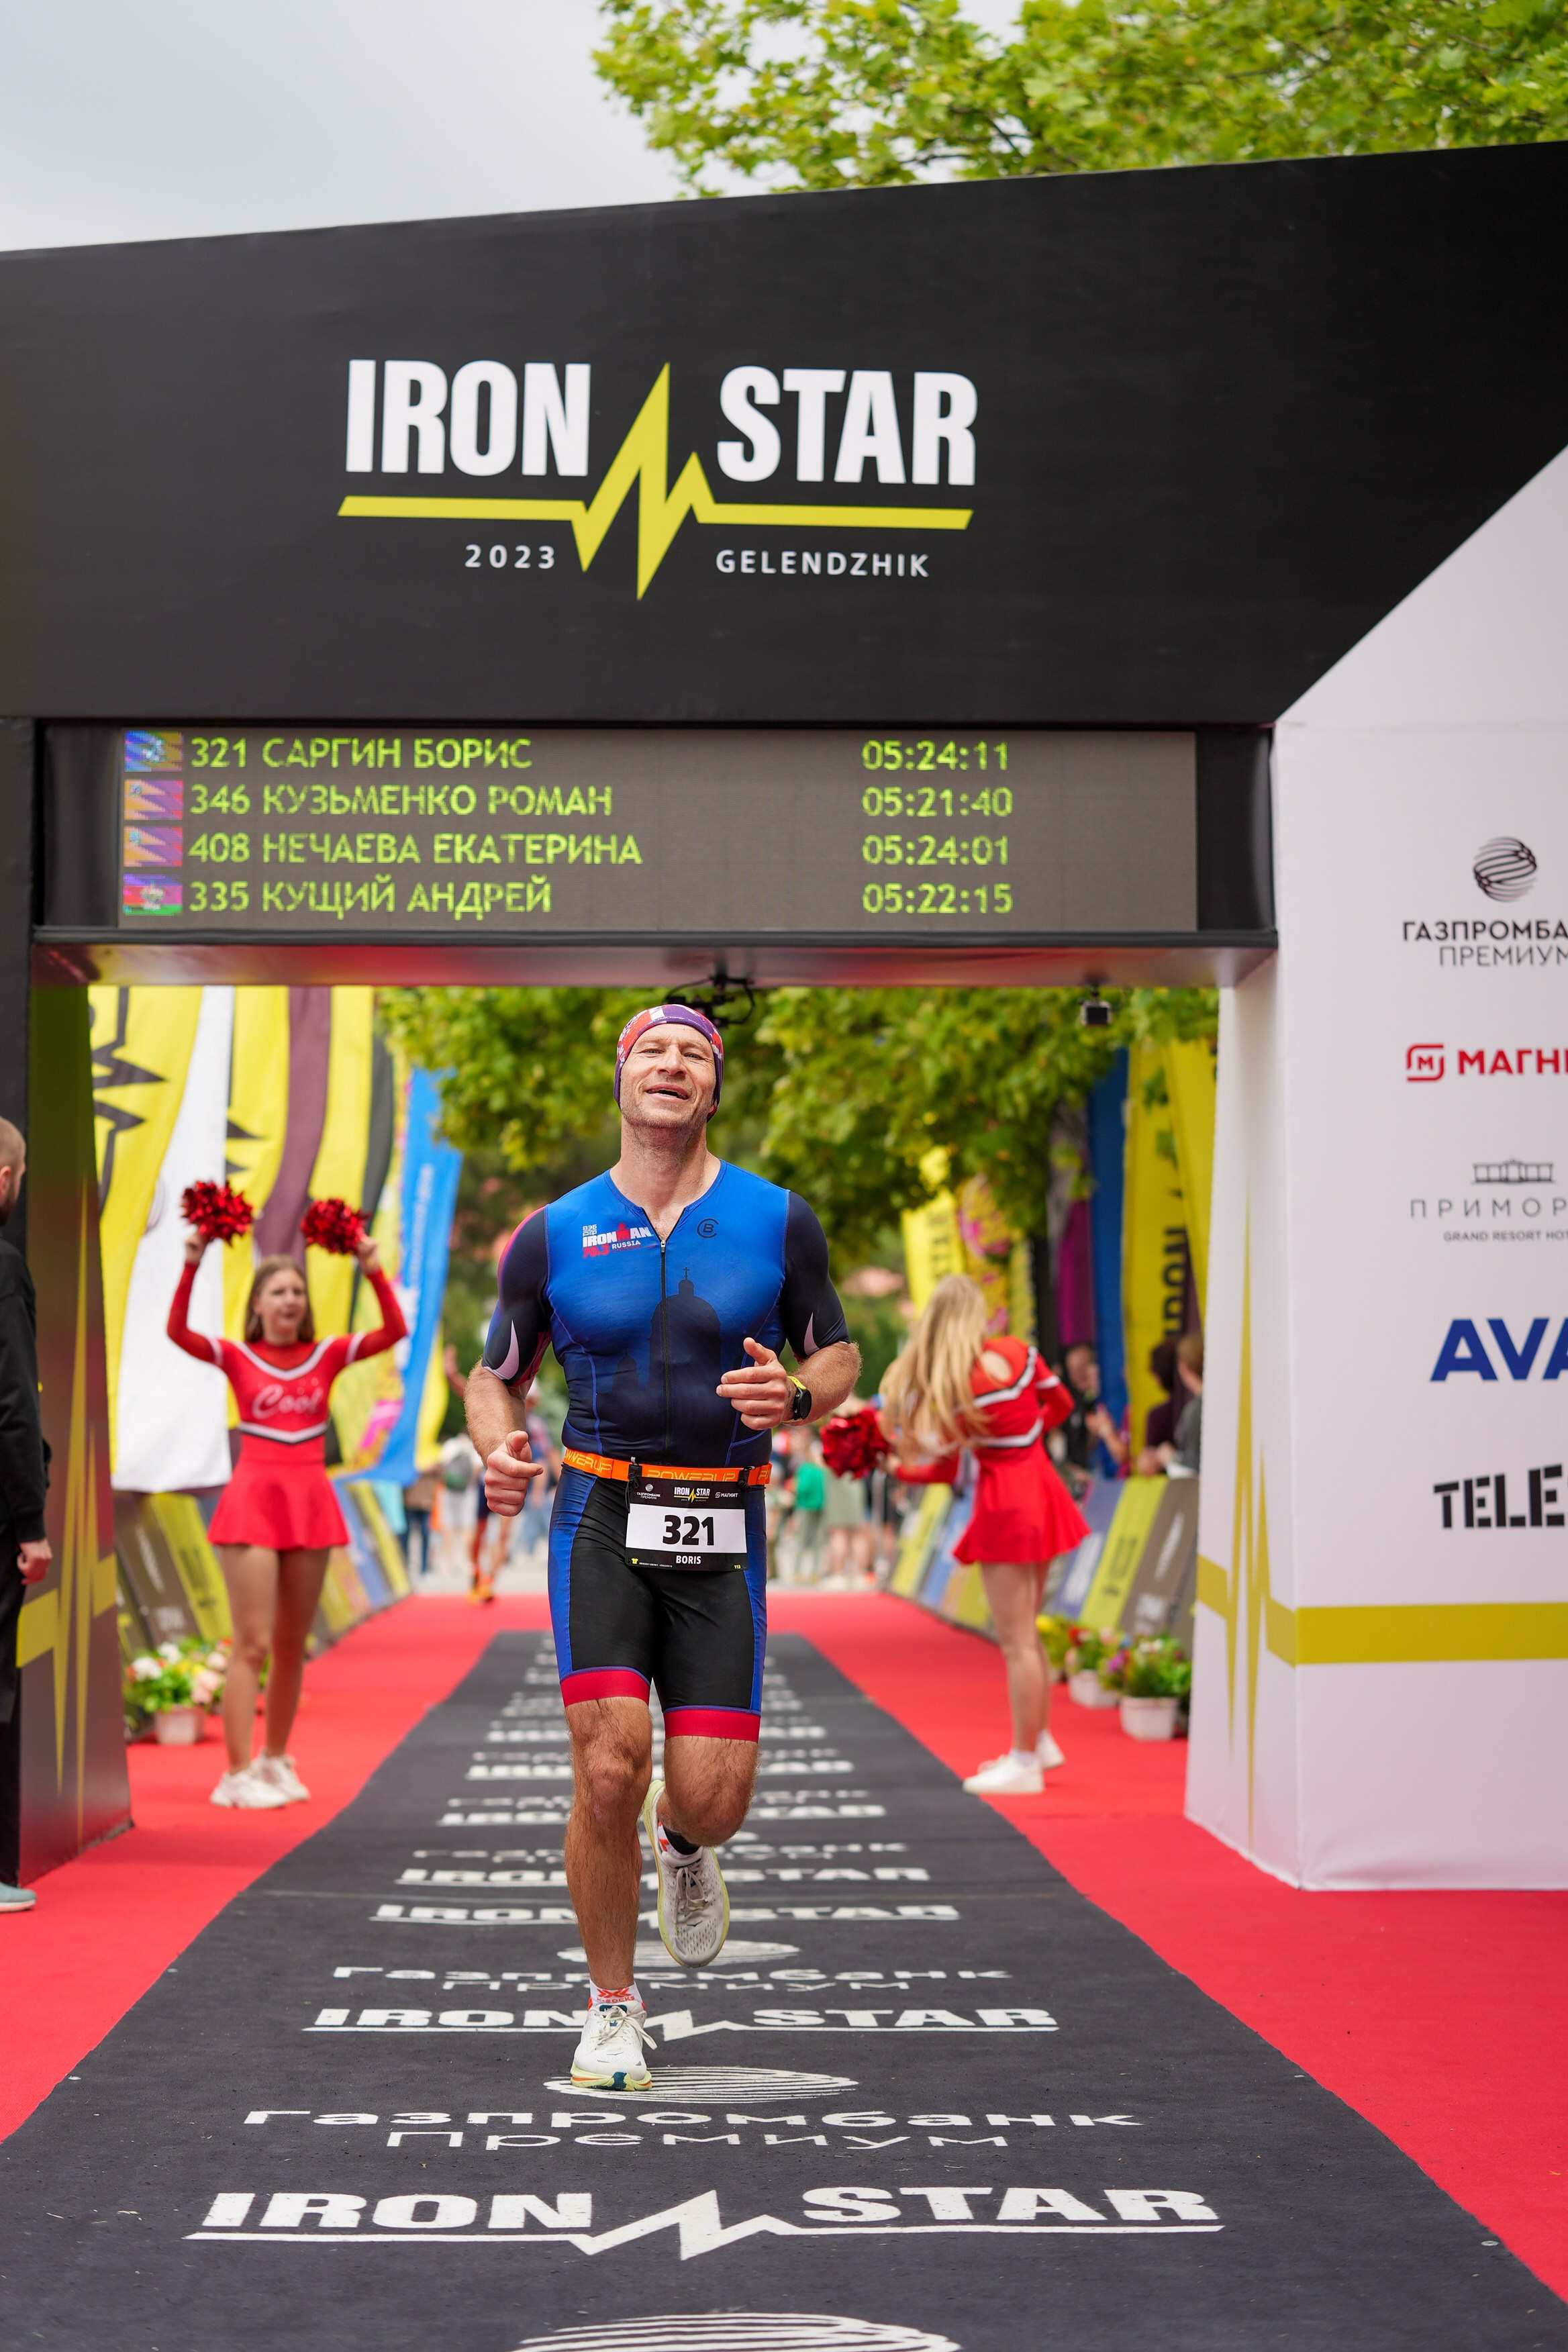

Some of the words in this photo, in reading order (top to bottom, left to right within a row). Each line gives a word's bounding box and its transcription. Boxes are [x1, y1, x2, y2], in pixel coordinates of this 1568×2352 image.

[346, 359, 591, 477] IRON
[717, 366, 977, 486] STAR
[464, 544, 555, 569] 2023
[716, 549, 929, 577] GELENDZHIK
[190, 736, 246, 768] 321
[262, 736, 402, 769] САРГИН
[413, 737, 533, 769] БОРИС
[861, 738, 1008, 771] 05:24:11
[190, 783, 251, 815] 346
[262, 783, 477, 816] КУЗЬМЕНКО
[487, 783, 613, 816] РОМАН
[861, 785, 1013, 817] 05:21:40
[187, 832, 250, 863] 408
[262, 832, 422, 864] НЕЧАЕВА
[433, 832, 644, 865] ЕКАТЕРИНА
[861, 833, 1008, 865] 05:24:01
[189, 880, 250, 912] 335
[262, 874, 395, 920] КУЩИЙ
[406, 875, 552, 920] АНДРЕЙ
[862, 881, 1014, 914] 05:22:15
[1402, 918, 1568, 942] ГАЗПРОМБА
[1457, 1048, 1568, 1075] МАГН
[1410, 1196, 1568, 1218] ПРИМОР
[583, 1226, 652, 1247] IRONMAN
[1443, 1230, 1489, 1242] GRAND
[1492, 1229, 1542, 1242] RESORT
[583, 1244, 609, 1258] 70.3
[611, 1240, 641, 1249] RUSSIA
[251, 1383, 324, 1419] Cool
[674, 1486, 690, 1496] IRON
[696, 1488, 710, 1496] STAR
[1433, 1463, 1567, 1529] TELE
[663, 1514, 714, 1546] 321
[675, 1555, 701, 1565] BORIS
[442, 1981, 910, 1992] Прмиум
[314, 2008, 588, 2027] IRON
[752, 2009, 1058, 2027] STAR
[243, 2110, 1144, 2128] Газпромбанк
[386, 2131, 1009, 2151] Премиум
[201, 2192, 593, 2228] IRON
[802, 2186, 1220, 2222] STAR
